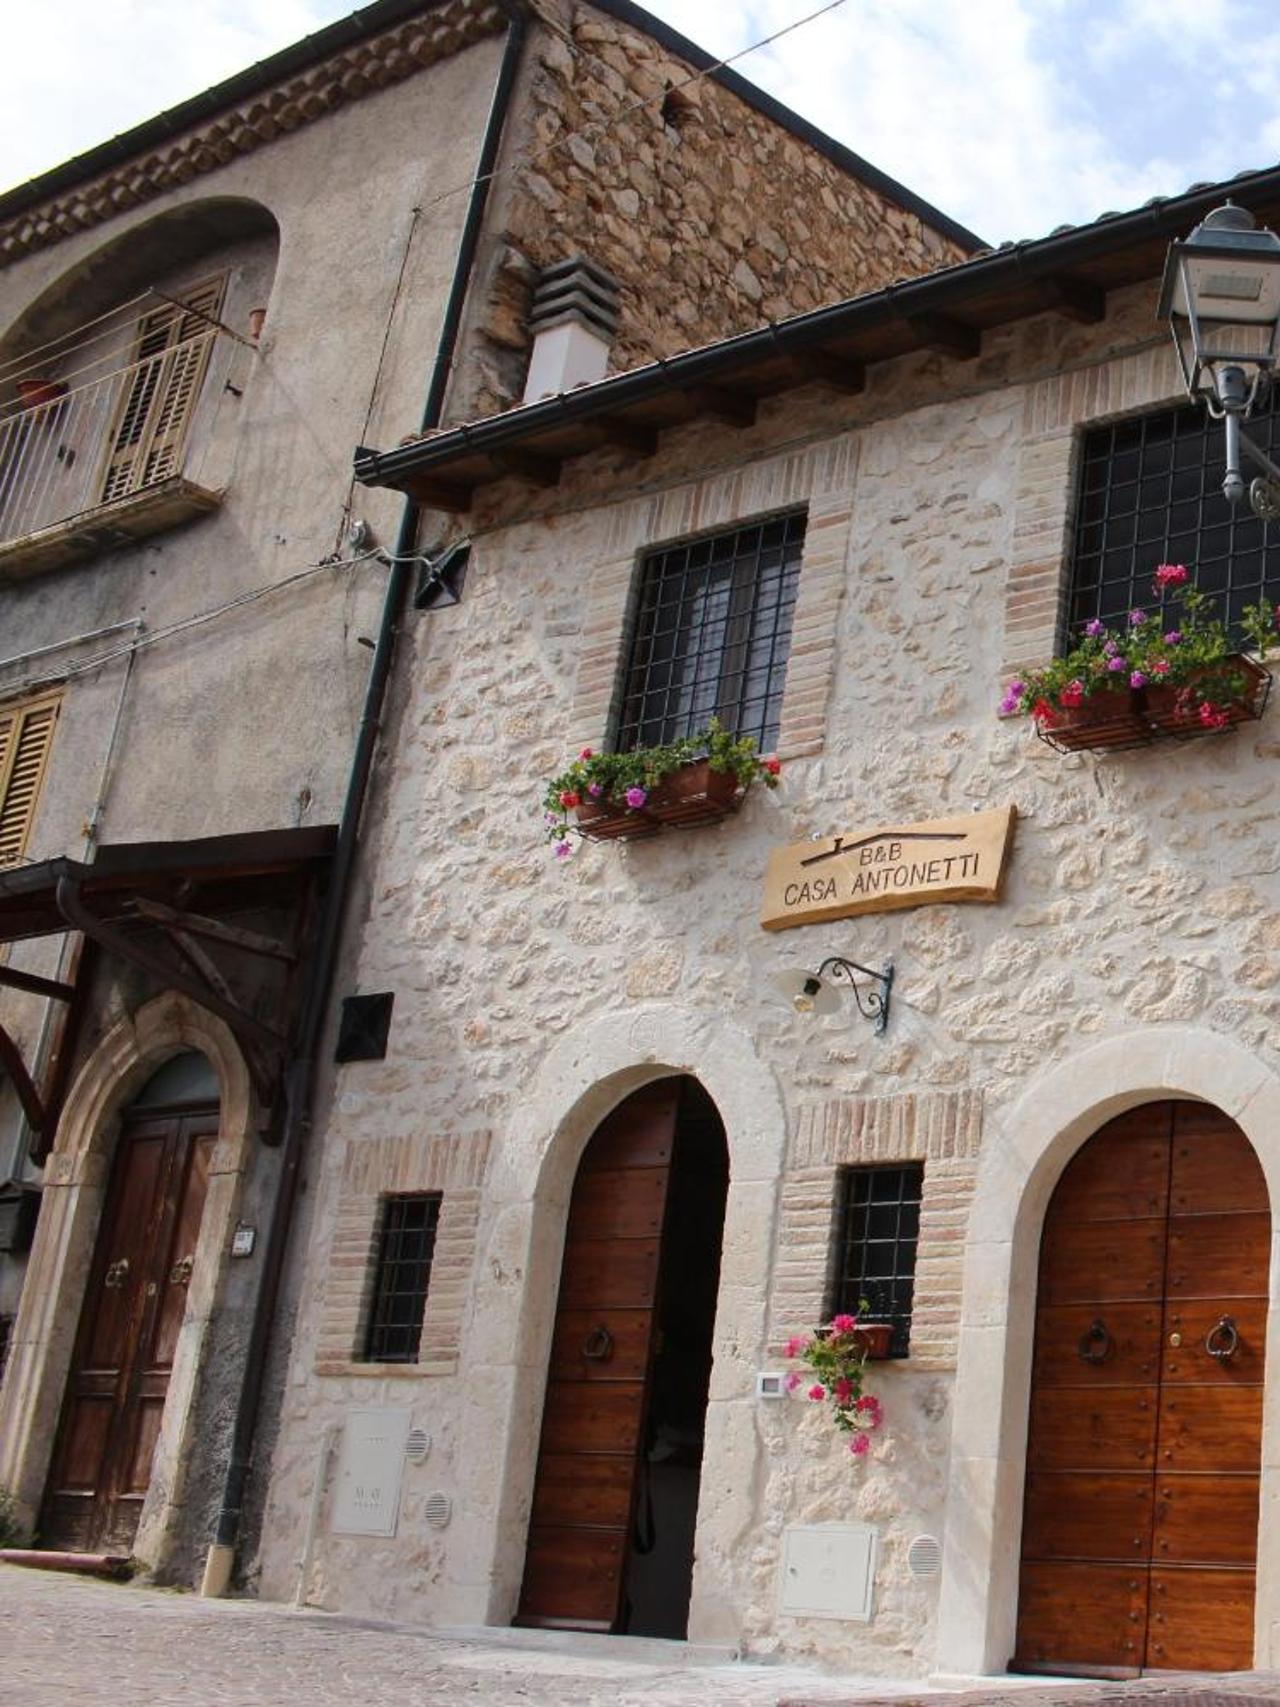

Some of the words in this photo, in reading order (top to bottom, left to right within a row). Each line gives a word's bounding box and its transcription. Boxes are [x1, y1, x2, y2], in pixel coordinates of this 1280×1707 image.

[860, 843, 902, 866] B&B
[784, 877, 837, 906] CASA
[851, 853, 979, 895] ANTONETTI
